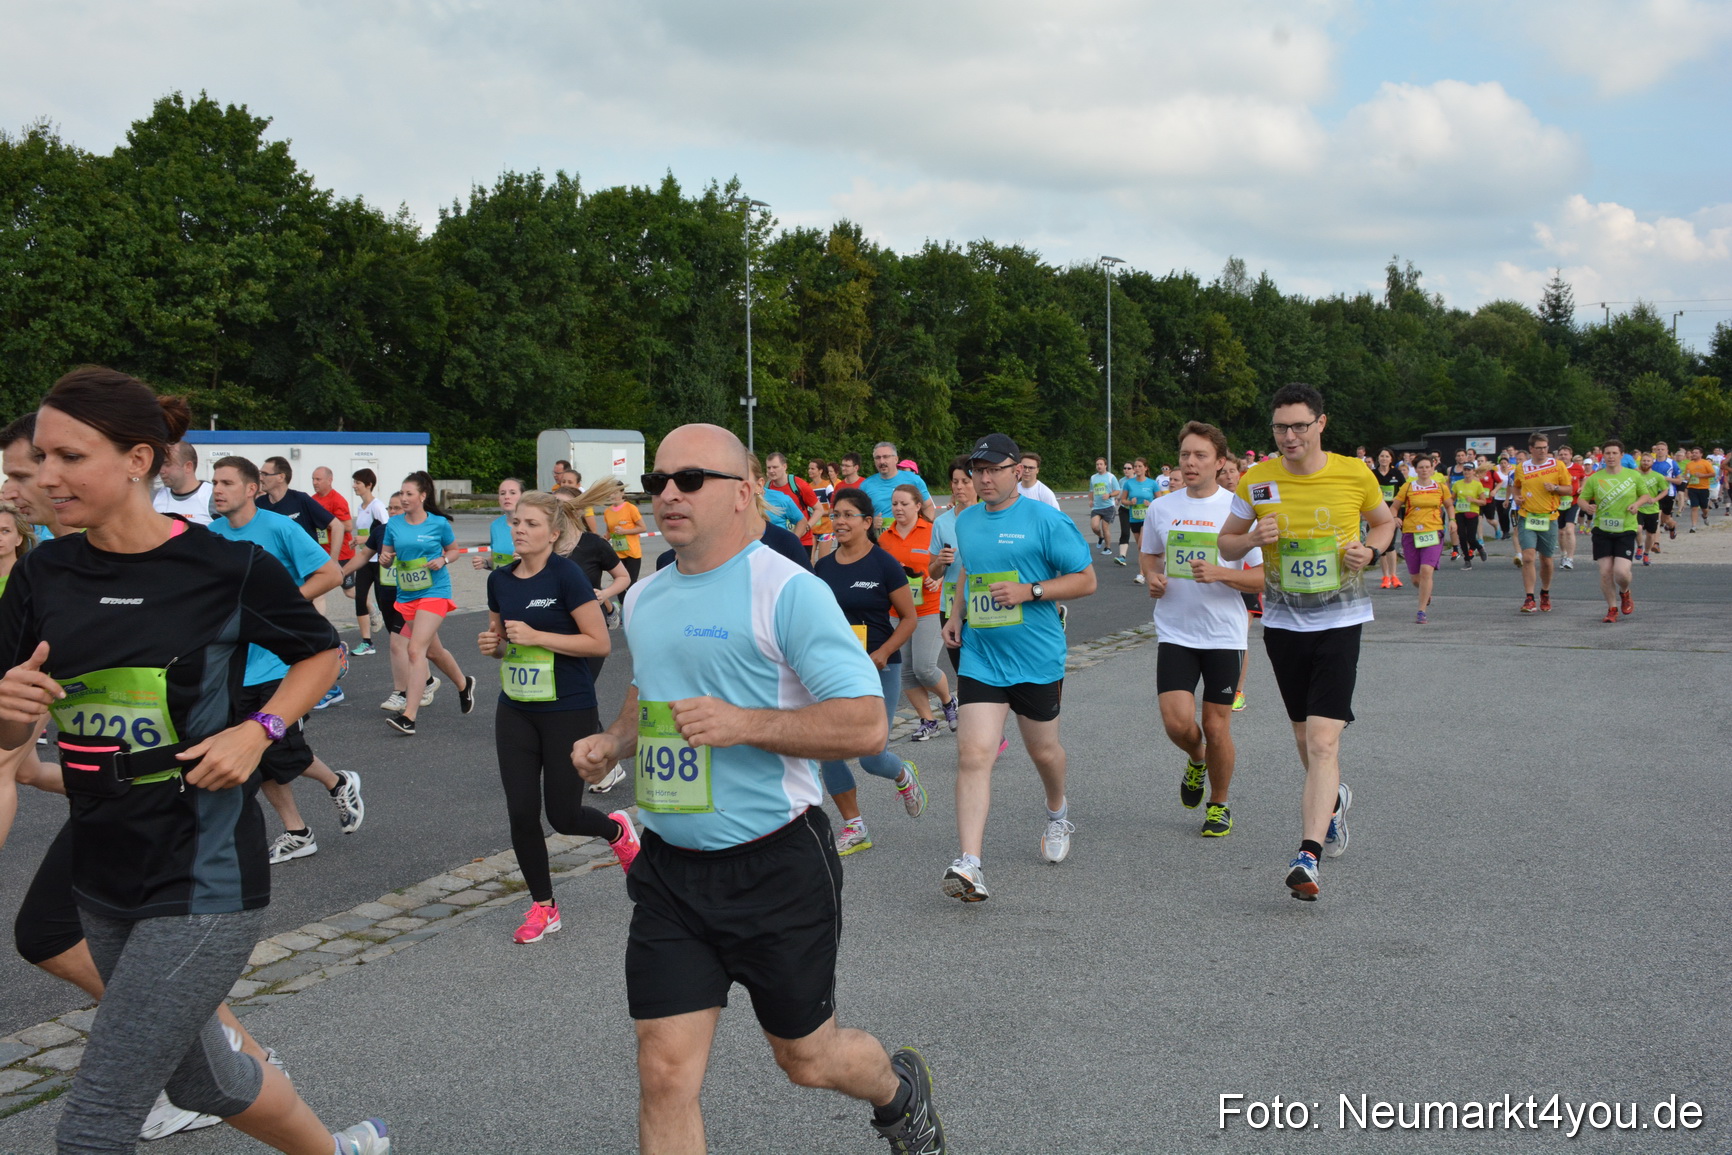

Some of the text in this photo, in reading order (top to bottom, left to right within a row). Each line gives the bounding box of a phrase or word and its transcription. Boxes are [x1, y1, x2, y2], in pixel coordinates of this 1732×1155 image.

[1540, 467, 1559, 477] BÖGL
[1182, 519, 1216, 527] KLEBL
[1604, 519, 1620, 527] 199
[1419, 534, 1435, 542] 933
[1175, 549, 1206, 565] 548
[1290, 559, 1327, 578] 485
[400, 570, 428, 584] 1082
[692, 625, 729, 640] sumida
[508, 666, 540, 686] 707
[71, 711, 162, 748] 1226
[638, 743, 699, 782] 1498
[655, 788, 678, 797] Hörner
